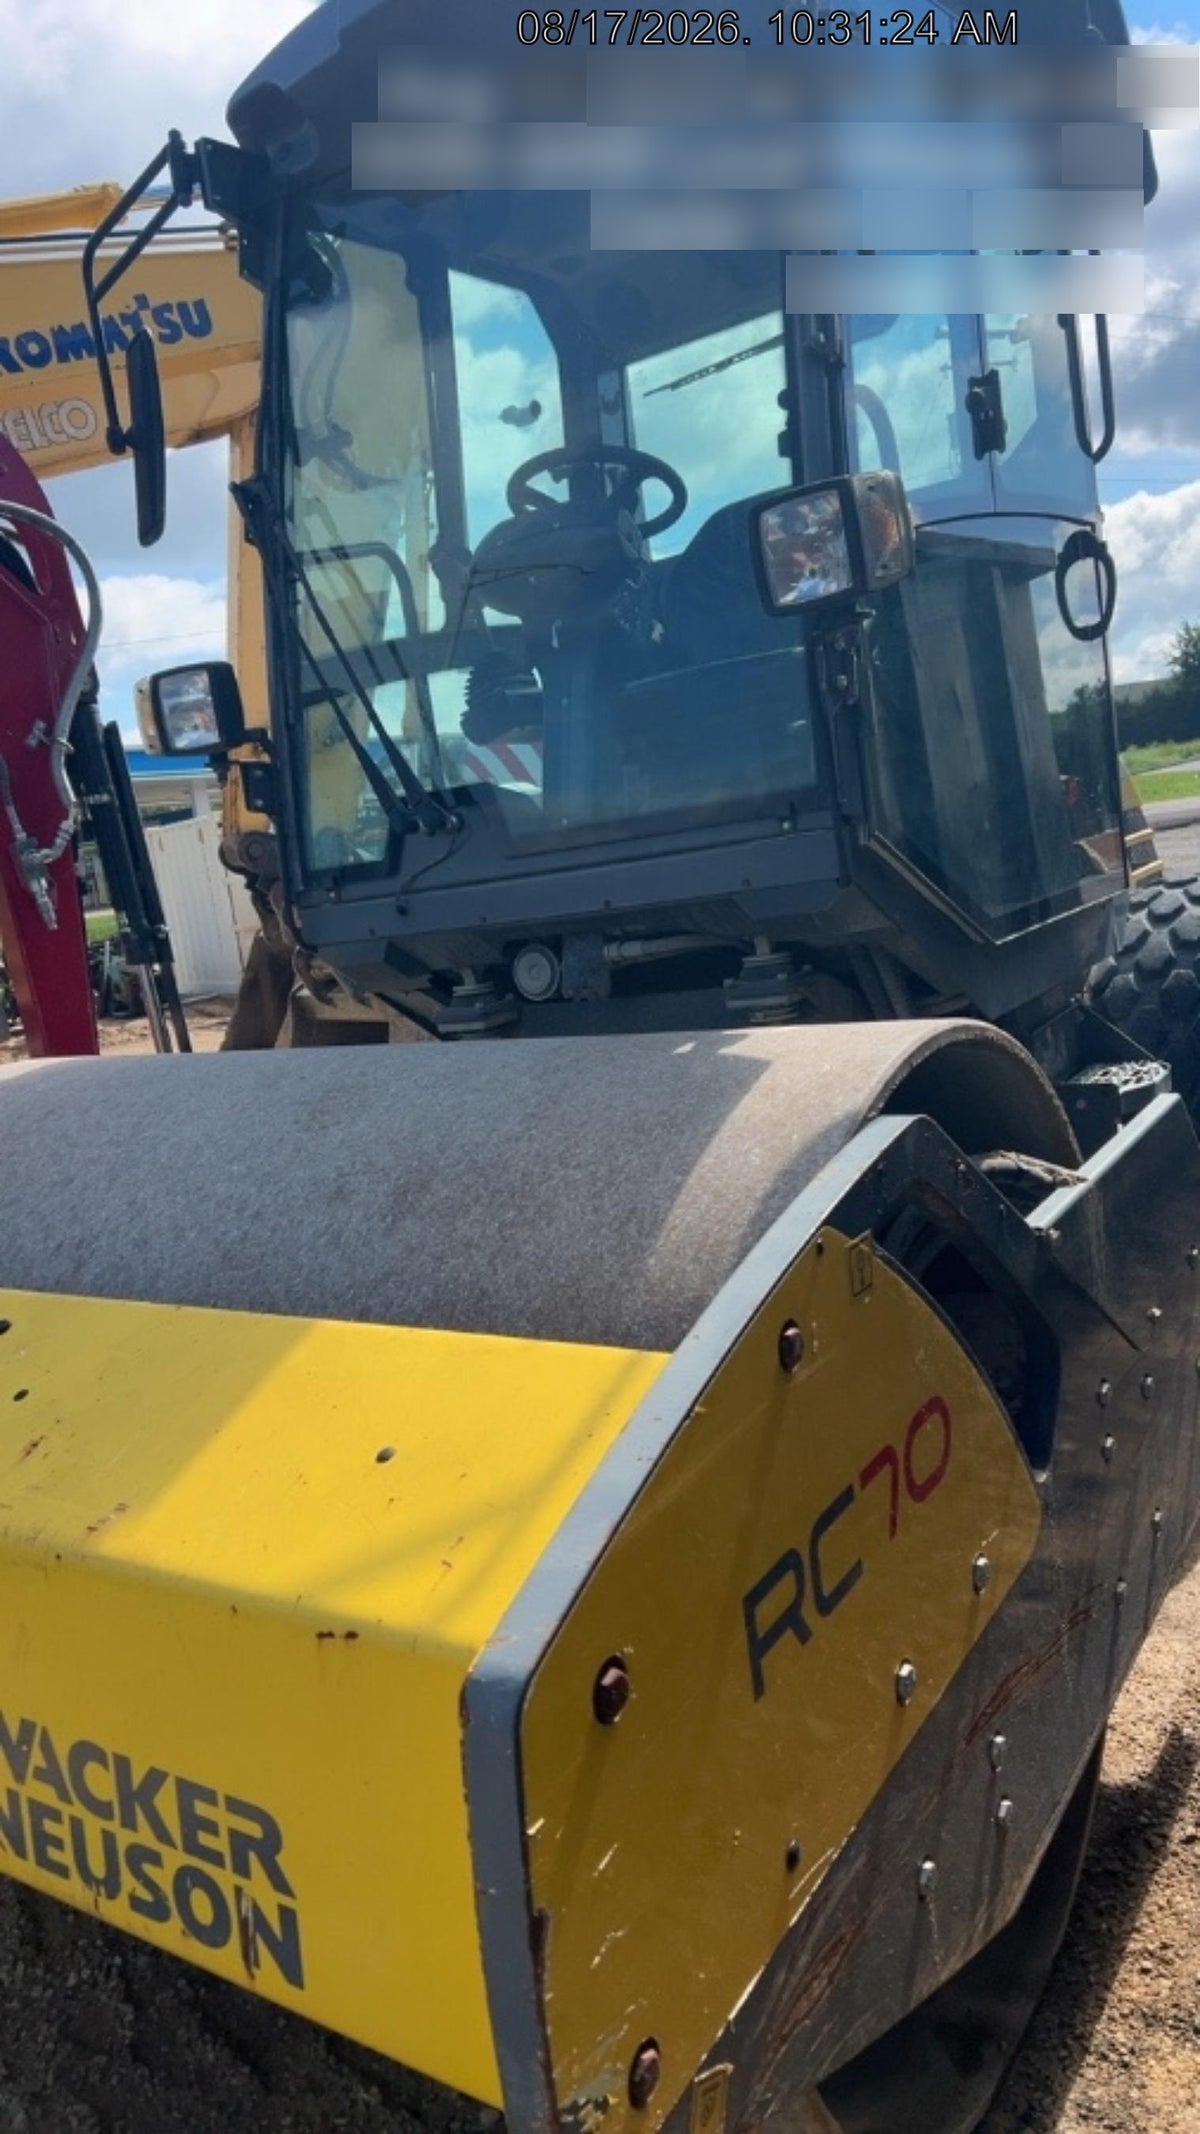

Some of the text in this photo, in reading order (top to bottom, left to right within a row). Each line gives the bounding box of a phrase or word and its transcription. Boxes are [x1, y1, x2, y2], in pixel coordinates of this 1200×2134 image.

[0, 398, 97, 450] ELCO
[743, 1395, 951, 1703] RC70
[0, 1787, 304, 1991] NEUSON
